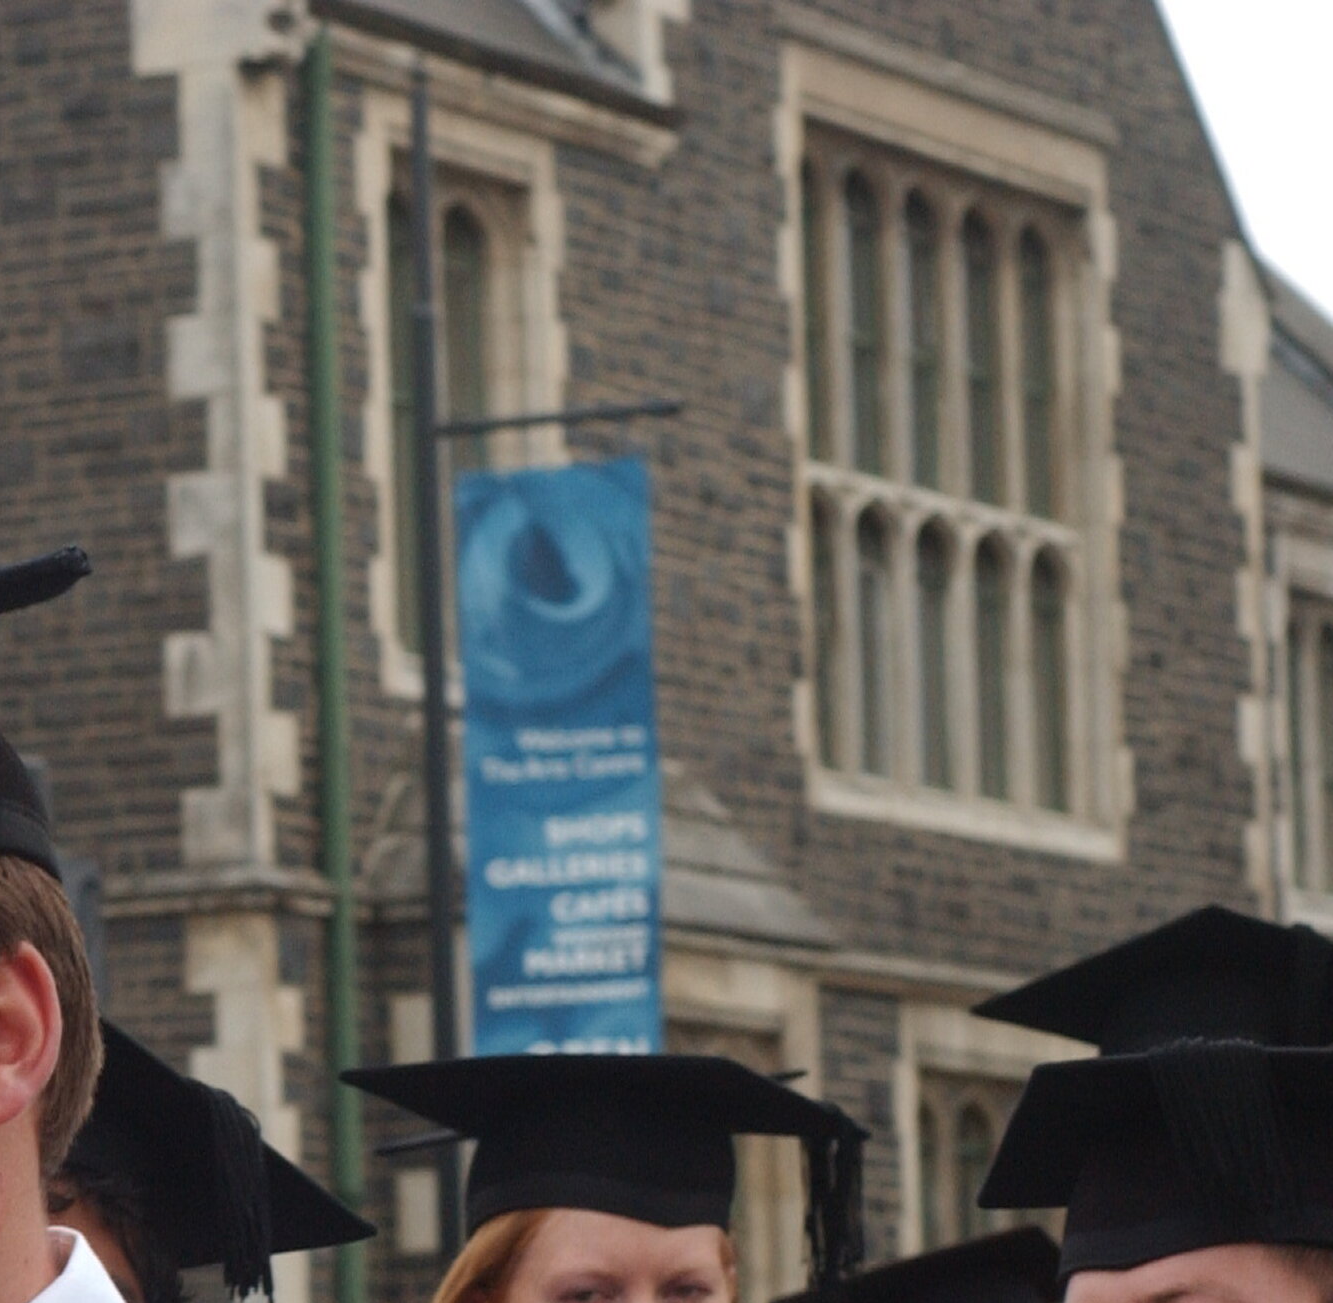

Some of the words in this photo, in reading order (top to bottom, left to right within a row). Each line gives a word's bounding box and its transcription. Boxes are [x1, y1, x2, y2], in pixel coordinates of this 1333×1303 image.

[543, 812, 648, 850] SHOPS
[485, 850, 648, 890] GALLERIES
[523, 944, 648, 977] MARKET
